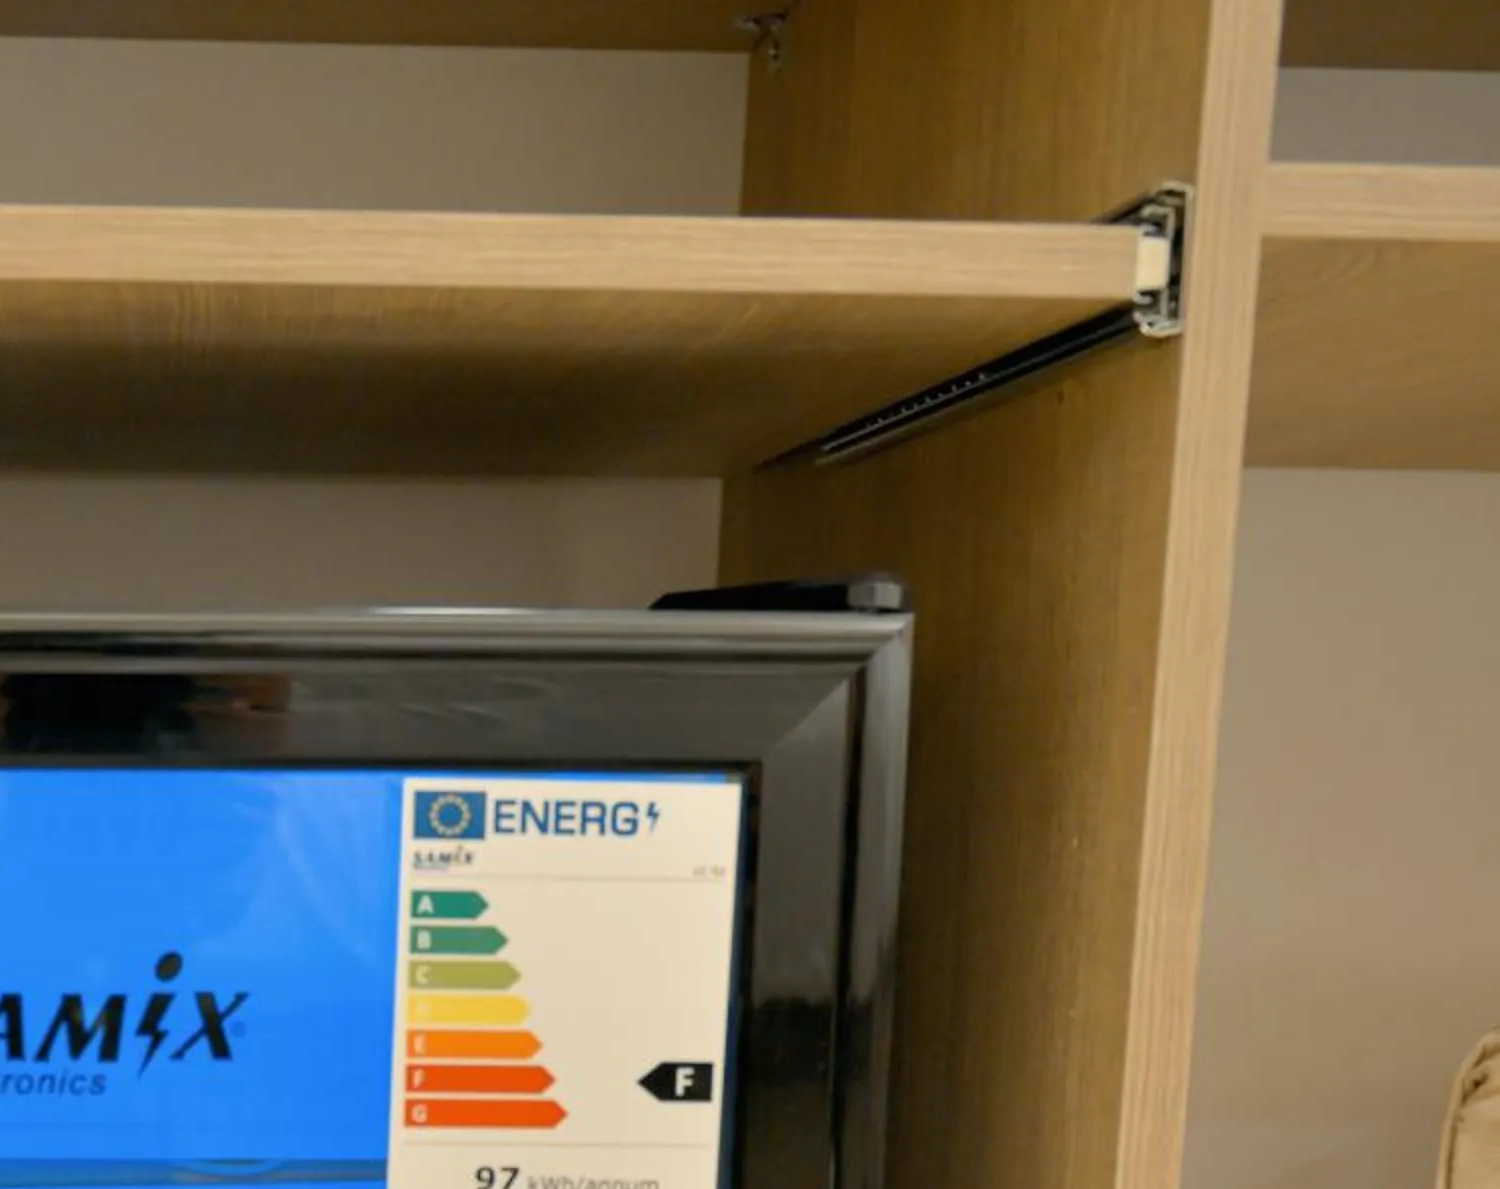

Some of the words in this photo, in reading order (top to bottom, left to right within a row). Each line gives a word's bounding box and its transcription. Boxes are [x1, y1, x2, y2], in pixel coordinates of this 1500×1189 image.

[417, 896, 435, 914] A
[416, 932, 432, 950] B
[415, 966, 431, 984] C
[674, 1067, 696, 1097] F
[411, 1103, 429, 1124] G
